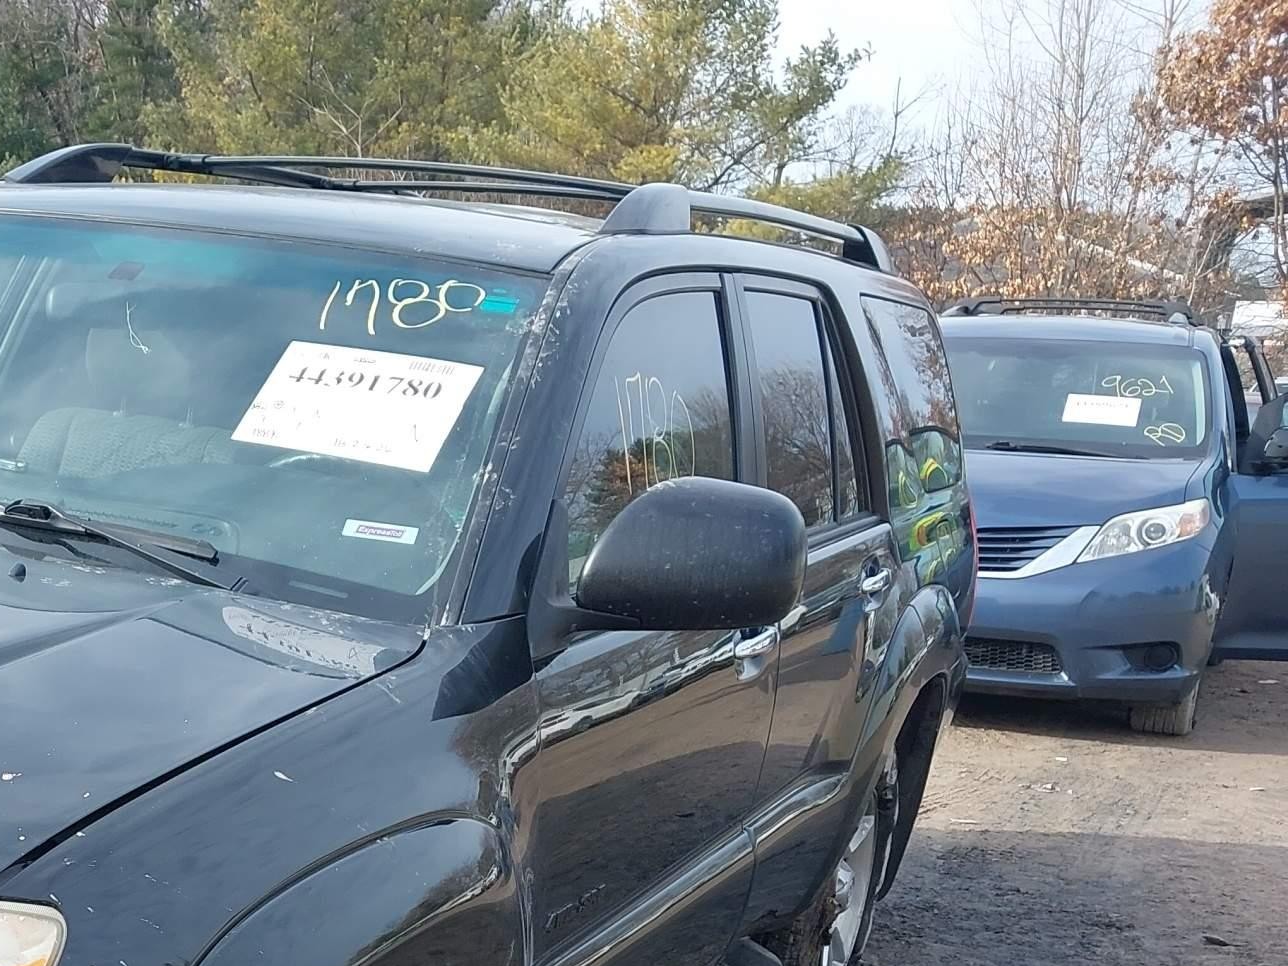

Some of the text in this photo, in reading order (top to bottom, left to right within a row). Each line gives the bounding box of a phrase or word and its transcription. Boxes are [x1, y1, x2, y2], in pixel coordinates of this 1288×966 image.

[318, 278, 486, 335] 1780
[288, 366, 443, 400] 44391780
[1101, 375, 1174, 398] 9621
